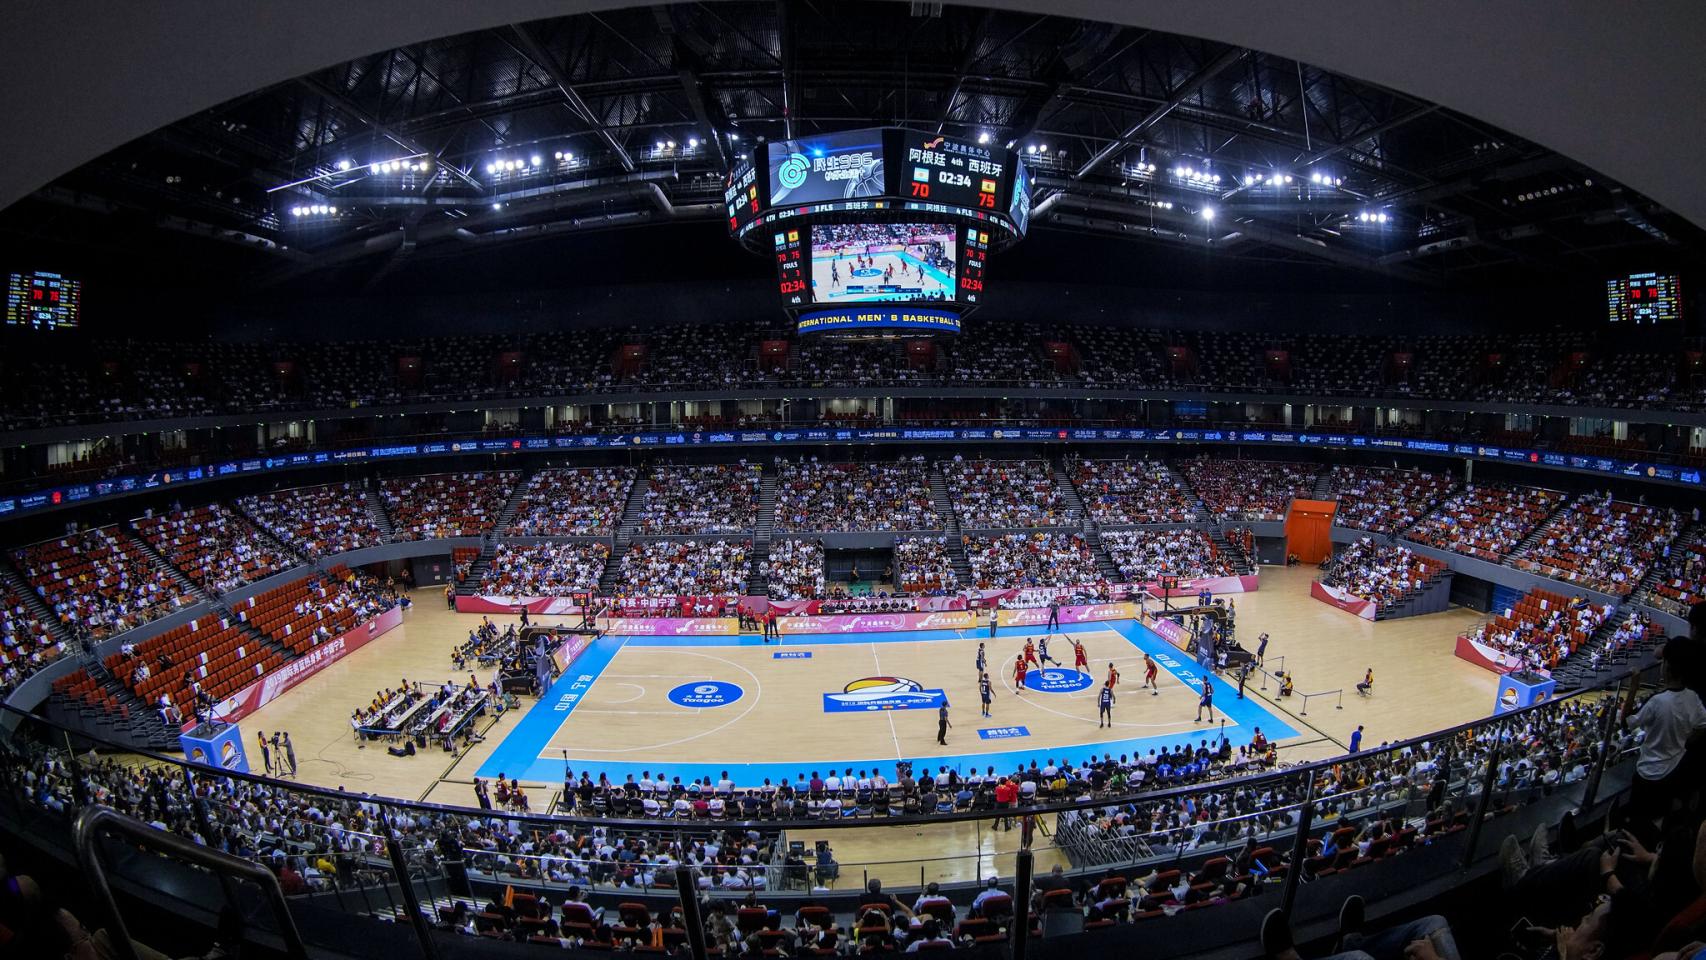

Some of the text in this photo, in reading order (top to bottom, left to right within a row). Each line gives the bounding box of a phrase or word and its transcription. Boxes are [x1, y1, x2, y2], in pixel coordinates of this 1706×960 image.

[909, 148, 946, 167] 阿根廷
[951, 158, 963, 167] 4th
[968, 159, 1002, 177] 西班牙
[939, 171, 972, 188] 02:34
[911, 182, 929, 198] 70
[979, 192, 995, 208] 75
[820, 204, 834, 212] FLS
[846, 202, 869, 210] 西班牙
[925, 203, 947, 213] 阿根廷
[766, 214, 776, 222] 4TH
[961, 209, 973, 217] FLS
[778, 251, 800, 263] 70 75
[966, 249, 986, 261] 70 75
[783, 261, 798, 270] FOULS
[968, 260, 982, 268] FOULS
[780, 279, 805, 294] 02:34
[961, 277, 983, 292] 02:34
[967, 294, 976, 302] 4th
[1631, 287, 1658, 299] 70 75
[791, 295, 801, 304] 4th
[902, 314, 954, 325] BASKETBALL
